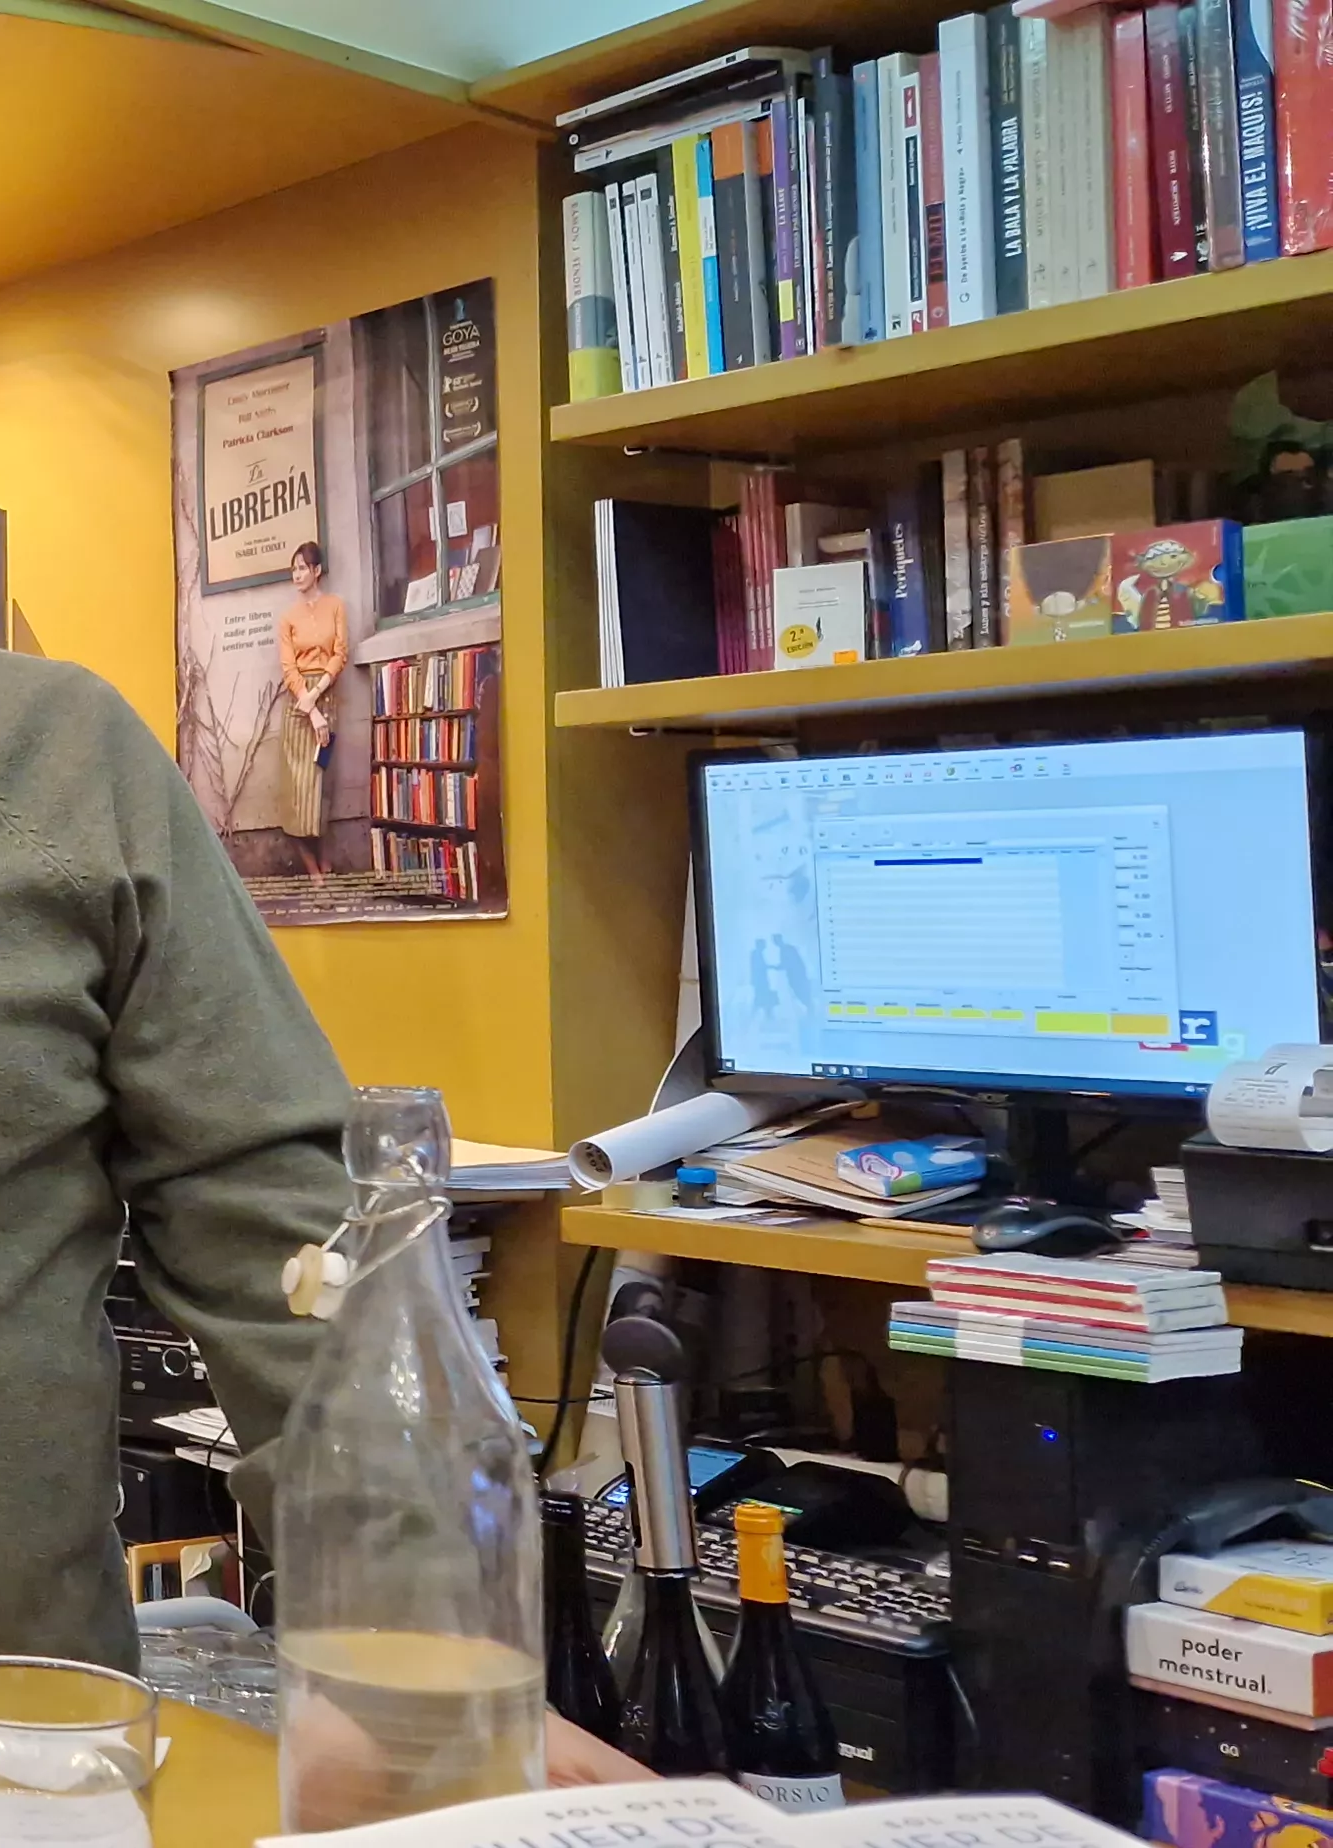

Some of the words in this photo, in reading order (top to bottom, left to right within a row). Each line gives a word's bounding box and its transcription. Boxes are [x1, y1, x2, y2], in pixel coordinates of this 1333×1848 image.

[1240, 91, 1267, 160] MAQUIS!
[1000, 116, 1019, 172] PALABRA
[1002, 173, 1020, 191] LA
[1244, 162, 1267, 184] EL
[1002, 192, 1021, 203] Y
[1244, 186, 1272, 231] ¡VIVA
[1003, 205, 1022, 237] BALA
[1004, 239, 1023, 257] LA
[442, 325, 482, 346] GOYA
[222, 433, 255, 450] Patricia
[256, 424, 294, 444] Clarkson
[209, 466, 312, 542] LIBRERÍA
[224, 616, 246, 625] Entre
[248, 611, 272, 621] libros
[1181, 1636, 1244, 1664] poder
[1159, 1657, 1273, 1695] menstrual.
[545, 1806, 613, 1820] SOL
[626, 1798, 719, 1812] OTTO
[666, 1814, 755, 1838] DE
